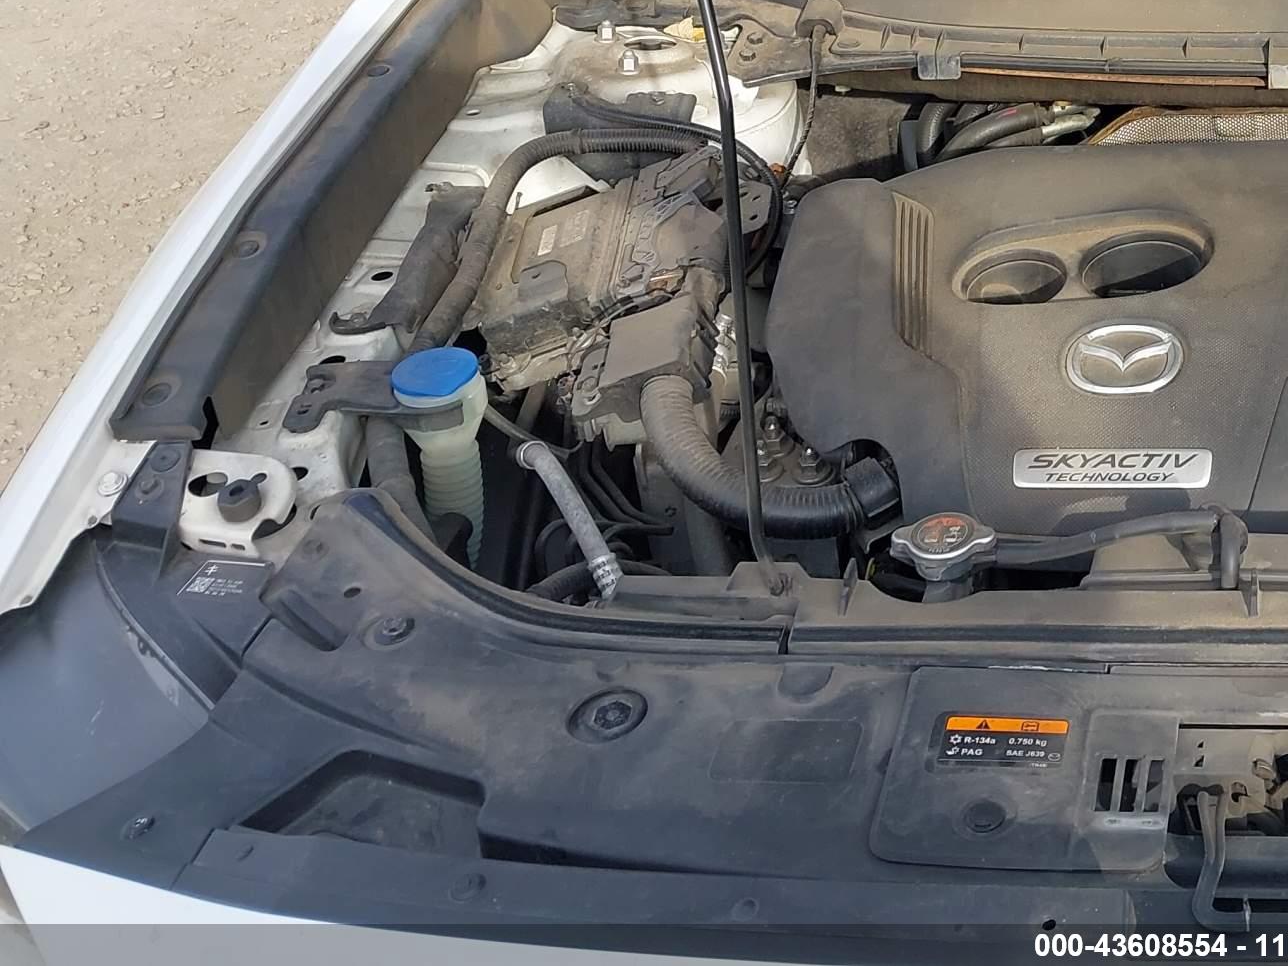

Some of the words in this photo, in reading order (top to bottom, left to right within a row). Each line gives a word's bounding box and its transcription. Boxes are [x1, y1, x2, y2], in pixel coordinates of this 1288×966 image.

[1027, 453, 1199, 469] SKYACTIV
[1045, 472, 1175, 482] TECHNOLOGY
[963, 736, 996, 745] R-134a
[1008, 737, 1033, 746] 0.750
[1035, 738, 1048, 747] kg
[960, 748, 983, 756] PAG
